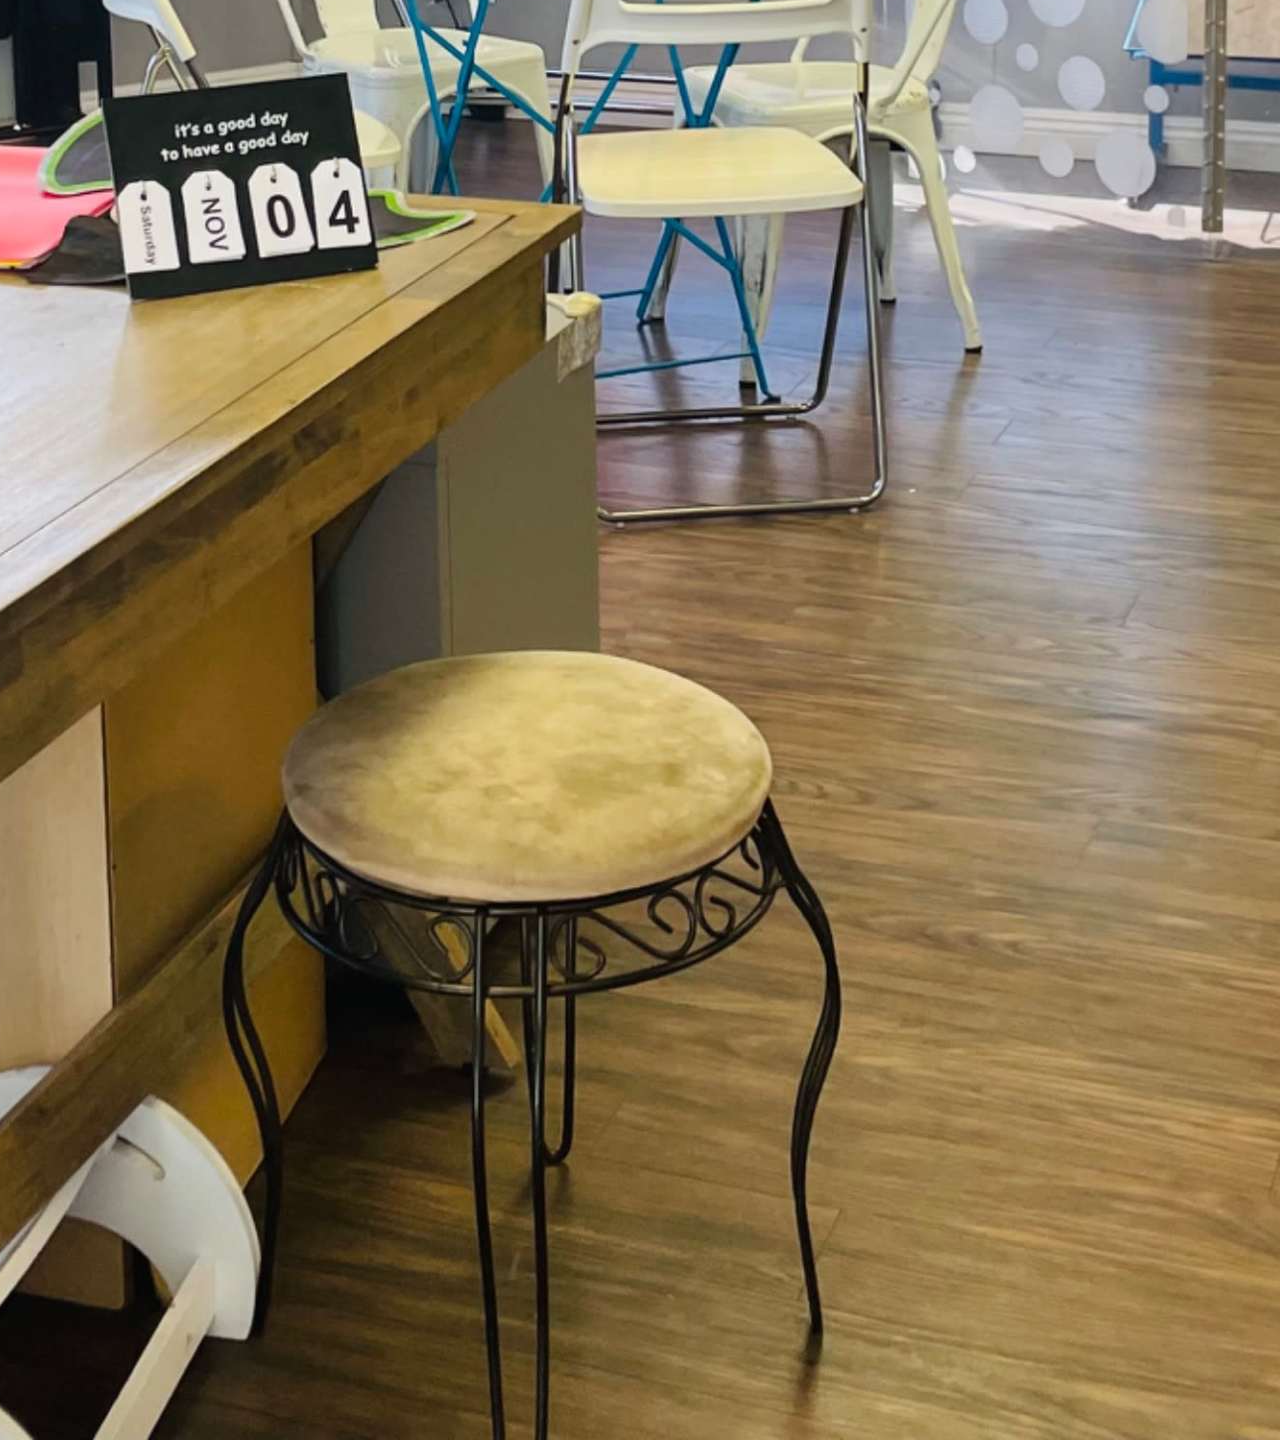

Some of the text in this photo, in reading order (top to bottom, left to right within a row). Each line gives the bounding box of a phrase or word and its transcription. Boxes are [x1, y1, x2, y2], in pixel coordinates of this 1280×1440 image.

[160, 130, 310, 162] to have a good day
[174, 111, 289, 139] it's a good day
[140, 205, 158, 266] Saturday
[201, 197, 230, 252] NOV
